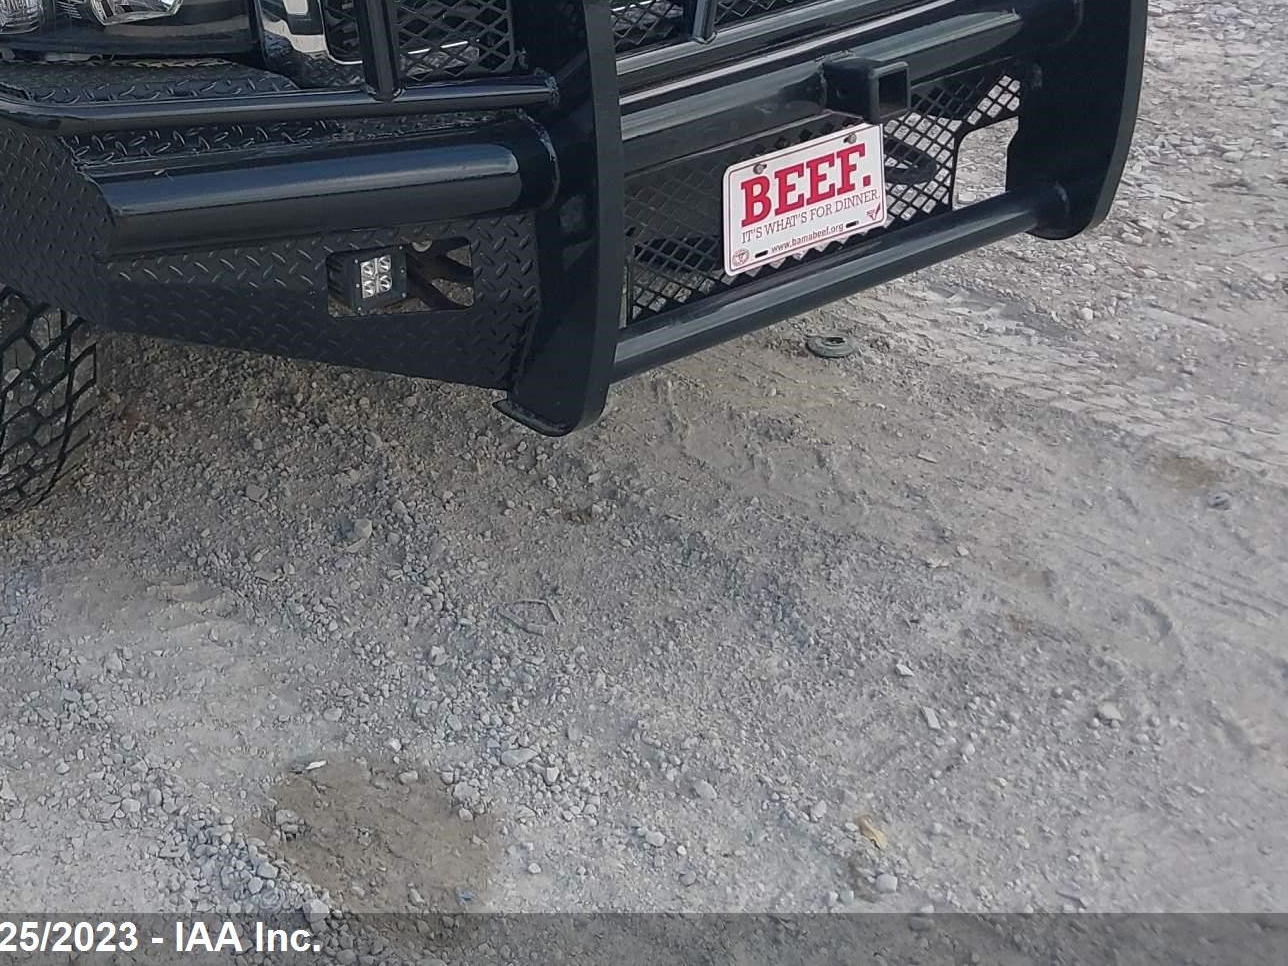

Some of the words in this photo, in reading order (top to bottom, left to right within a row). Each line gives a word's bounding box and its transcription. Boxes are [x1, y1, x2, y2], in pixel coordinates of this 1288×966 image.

[740, 143, 871, 227] BEEF.
[741, 227, 762, 244] IT'S
[764, 211, 807, 235] WHAT'S
[810, 204, 833, 220] FOR
[835, 189, 880, 213] DINNER.
[771, 222, 844, 253] www.bamabeef.org
